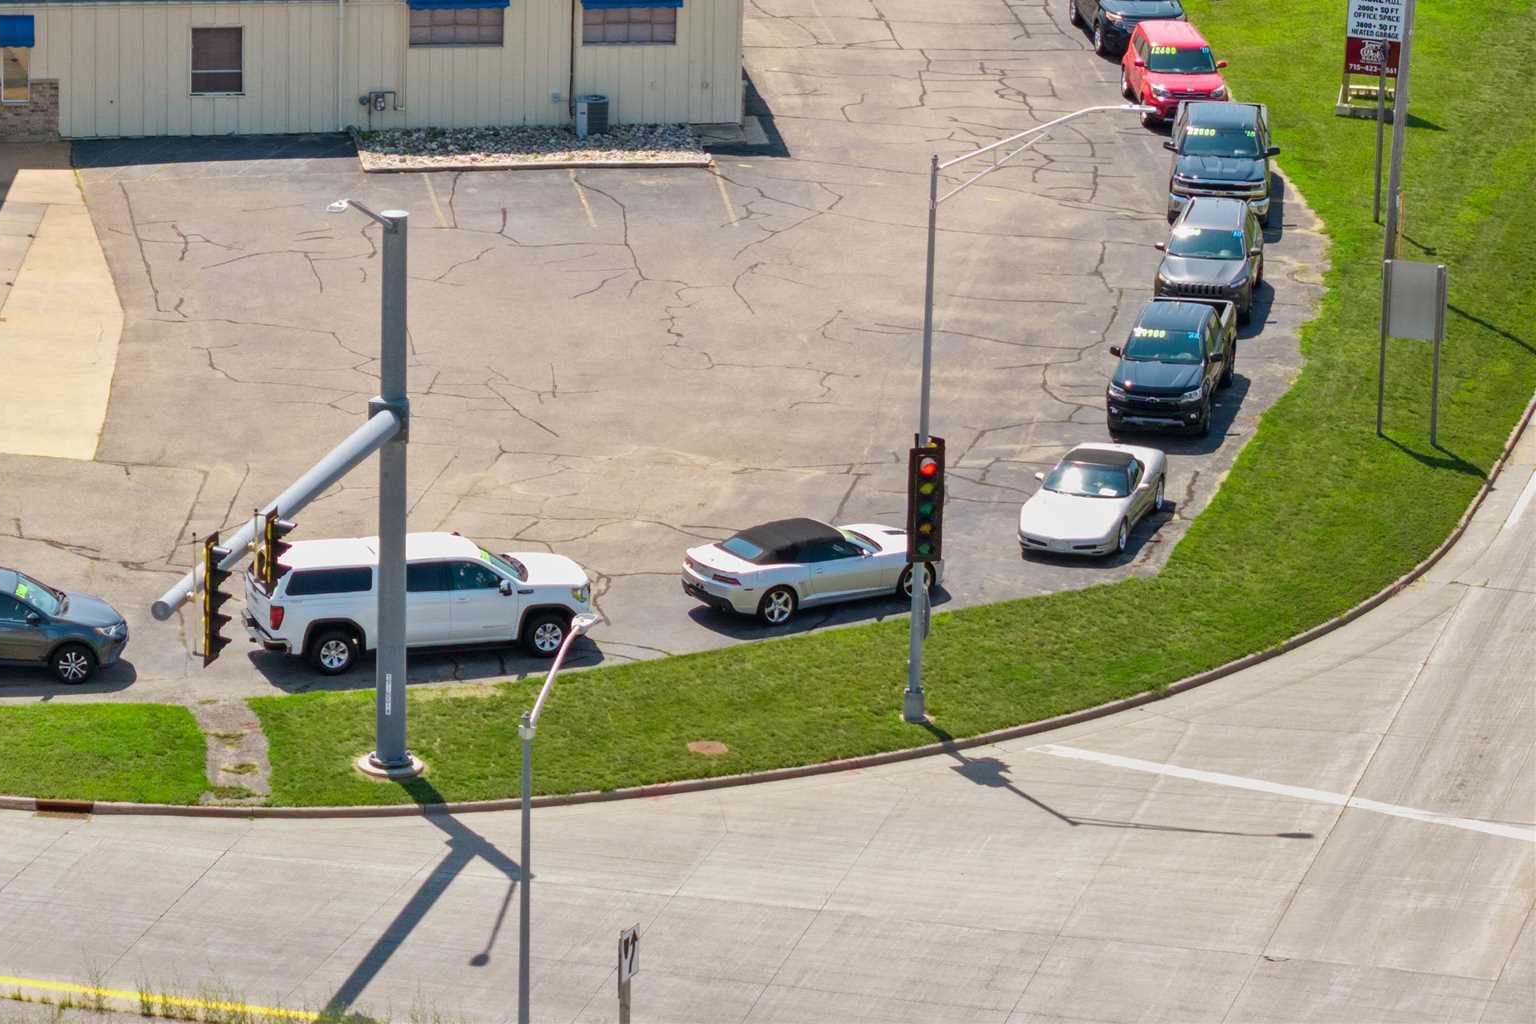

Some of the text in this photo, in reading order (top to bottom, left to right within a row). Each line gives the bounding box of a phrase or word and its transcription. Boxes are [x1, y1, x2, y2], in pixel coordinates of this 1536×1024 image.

[1353, 11, 1401, 23] OFFICE SPACE
[1351, 28, 1375, 37] HEATED
